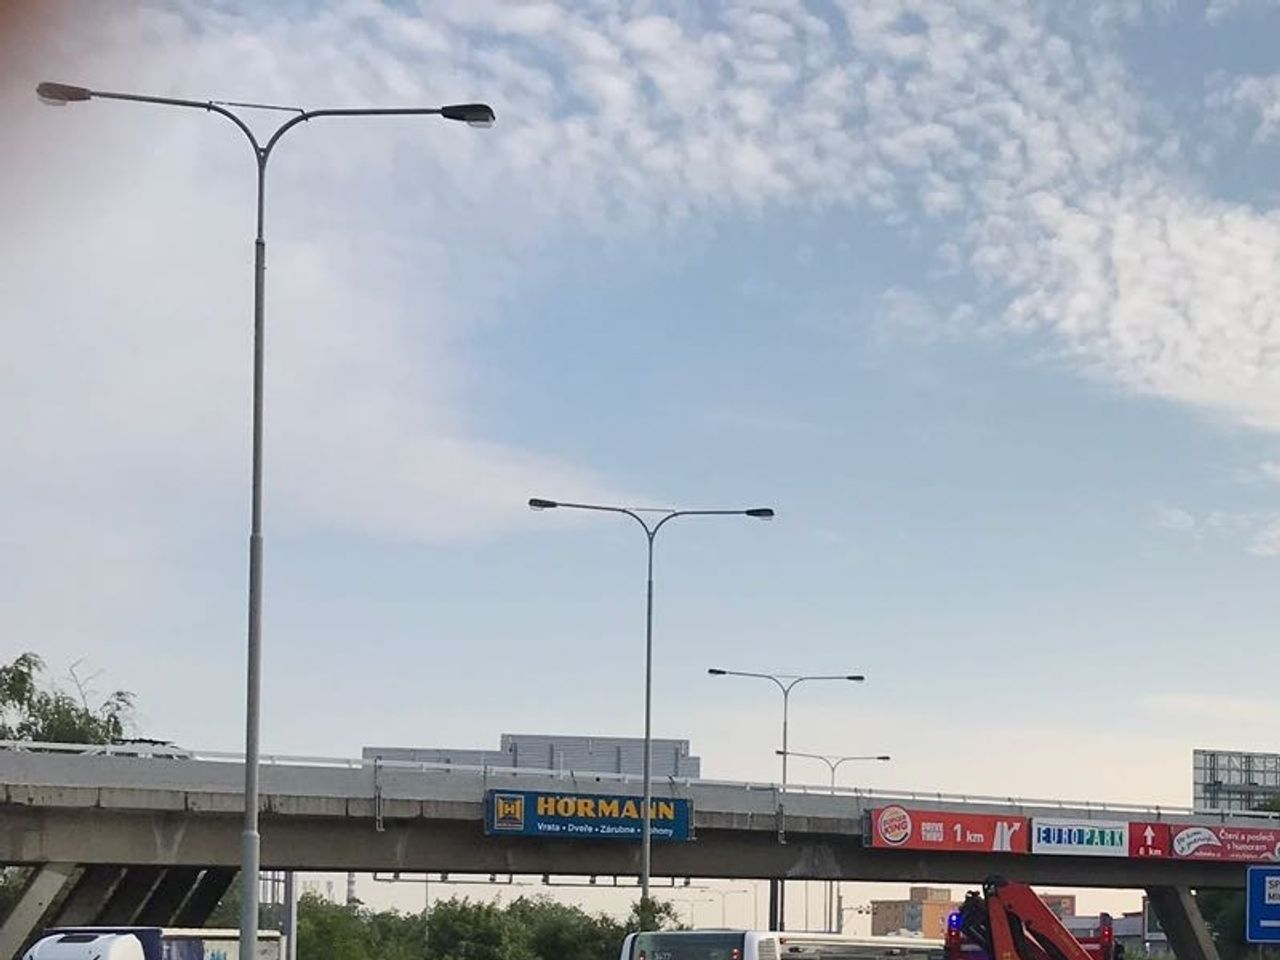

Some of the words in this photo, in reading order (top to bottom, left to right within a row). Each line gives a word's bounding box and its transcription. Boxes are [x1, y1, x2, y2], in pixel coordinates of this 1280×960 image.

[537, 795, 675, 820] HÖRMANN
[537, 822, 560, 832] Vrata
[645, 826, 673, 837] ohony
[884, 820, 908, 834] KING
[954, 824, 962, 842] 1
[966, 831, 984, 843] km
[1149, 847, 1162, 855] km
